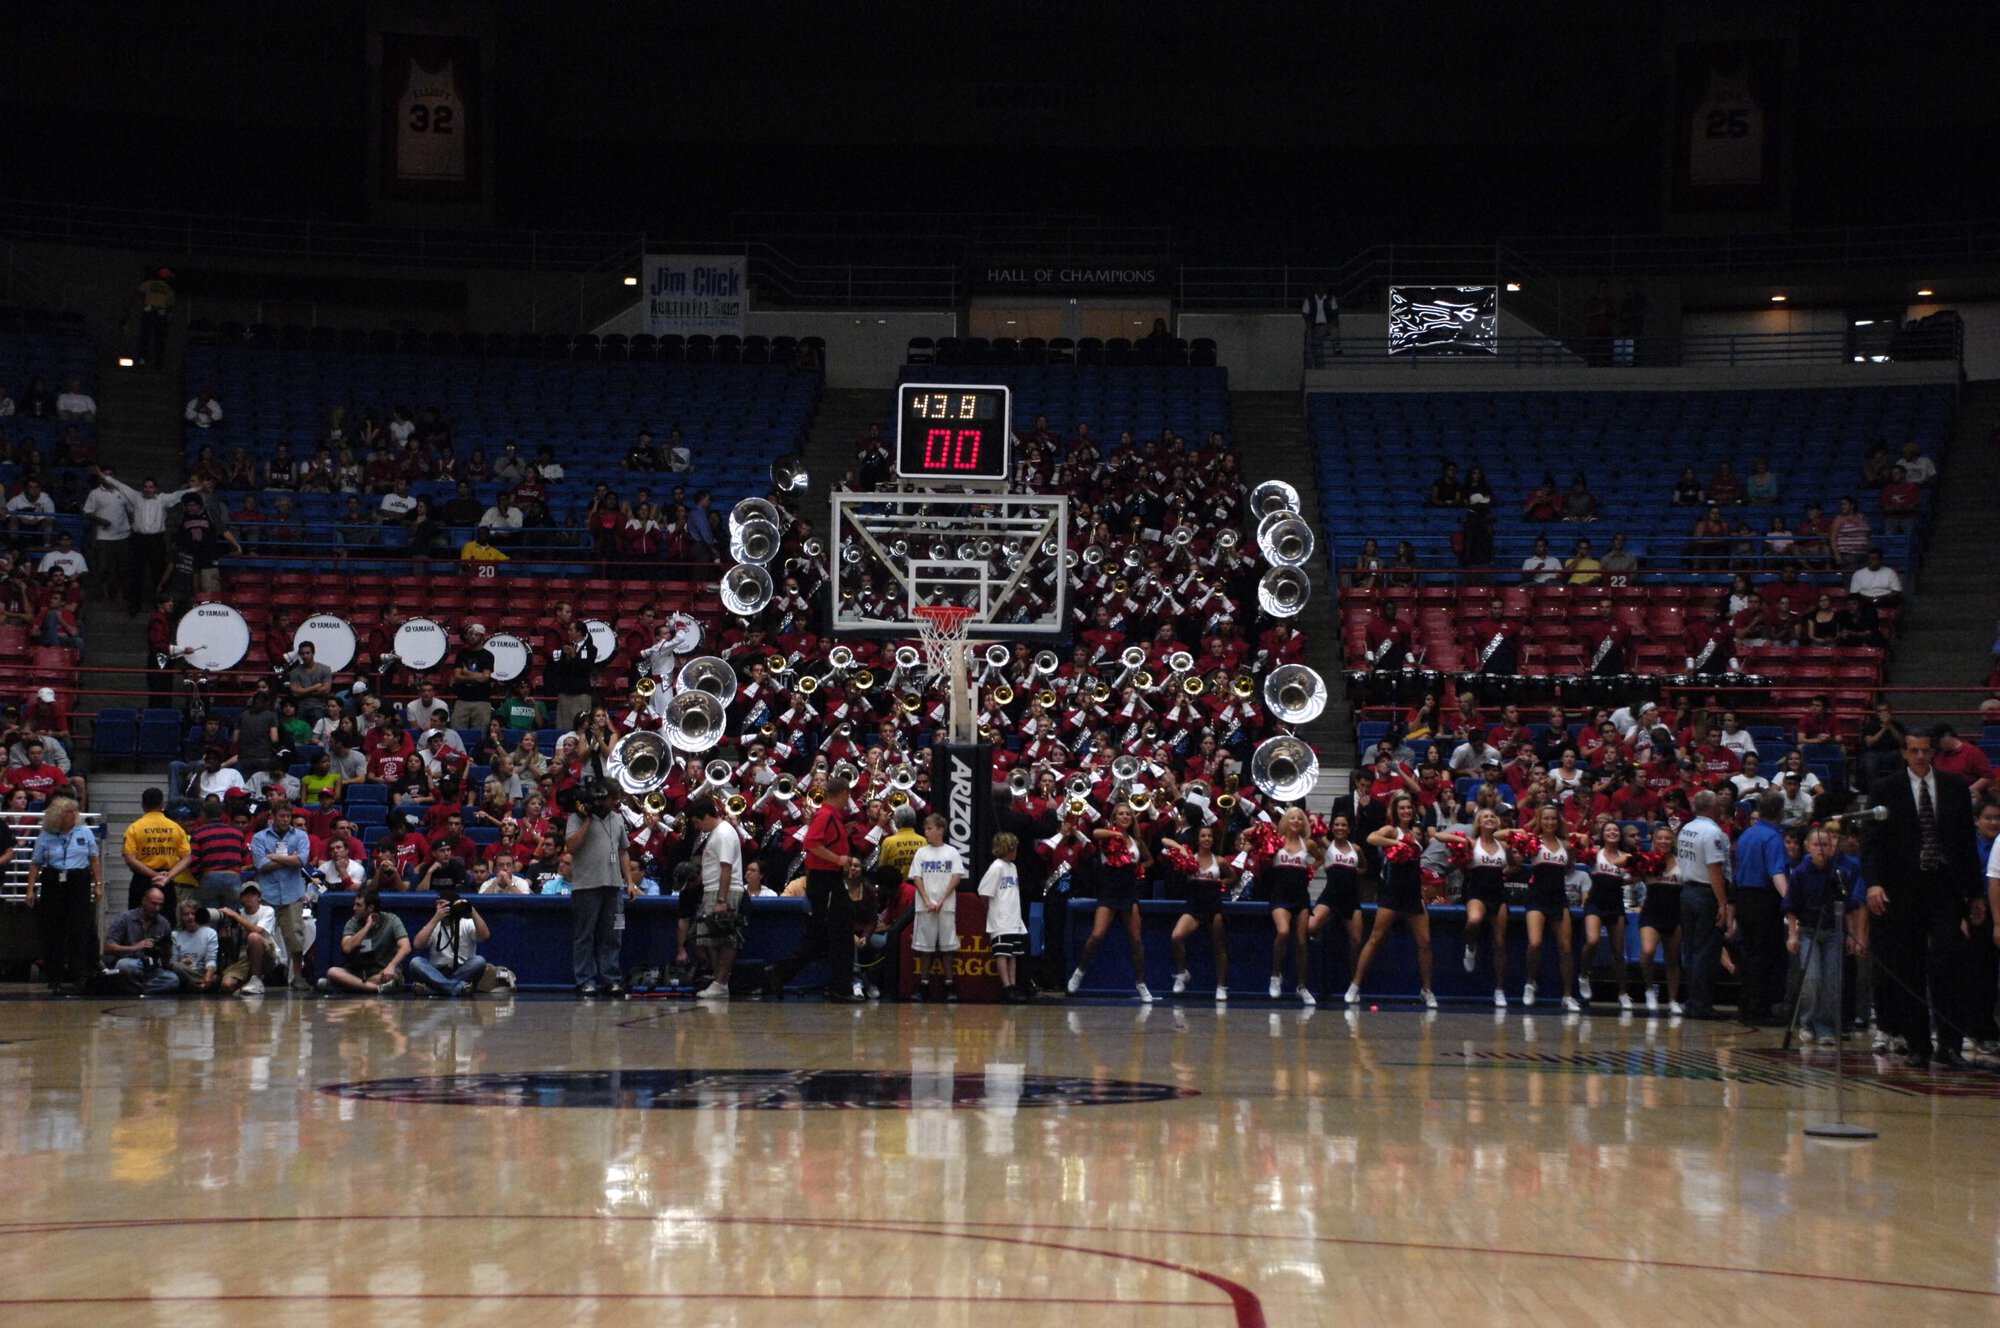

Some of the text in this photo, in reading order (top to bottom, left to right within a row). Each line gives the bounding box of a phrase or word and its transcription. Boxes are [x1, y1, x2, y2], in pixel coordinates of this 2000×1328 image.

[408, 103, 453, 134] 32
[1706, 109, 1749, 139] 25
[650, 267, 739, 297] Jim Click
[987, 268, 1156, 283] HALL OF CHAMPIONS
[913, 394, 977, 419] 43.8
[923, 427, 982, 470] 00
[478, 565, 495, 578] 20
[1610, 575, 1627, 588] 22
[496, 641, 519, 649] YAMAHA
[141, 846, 177, 856] SECURITY
[896, 840, 923, 848] EVENT
[537, 872, 559, 880] ZON
